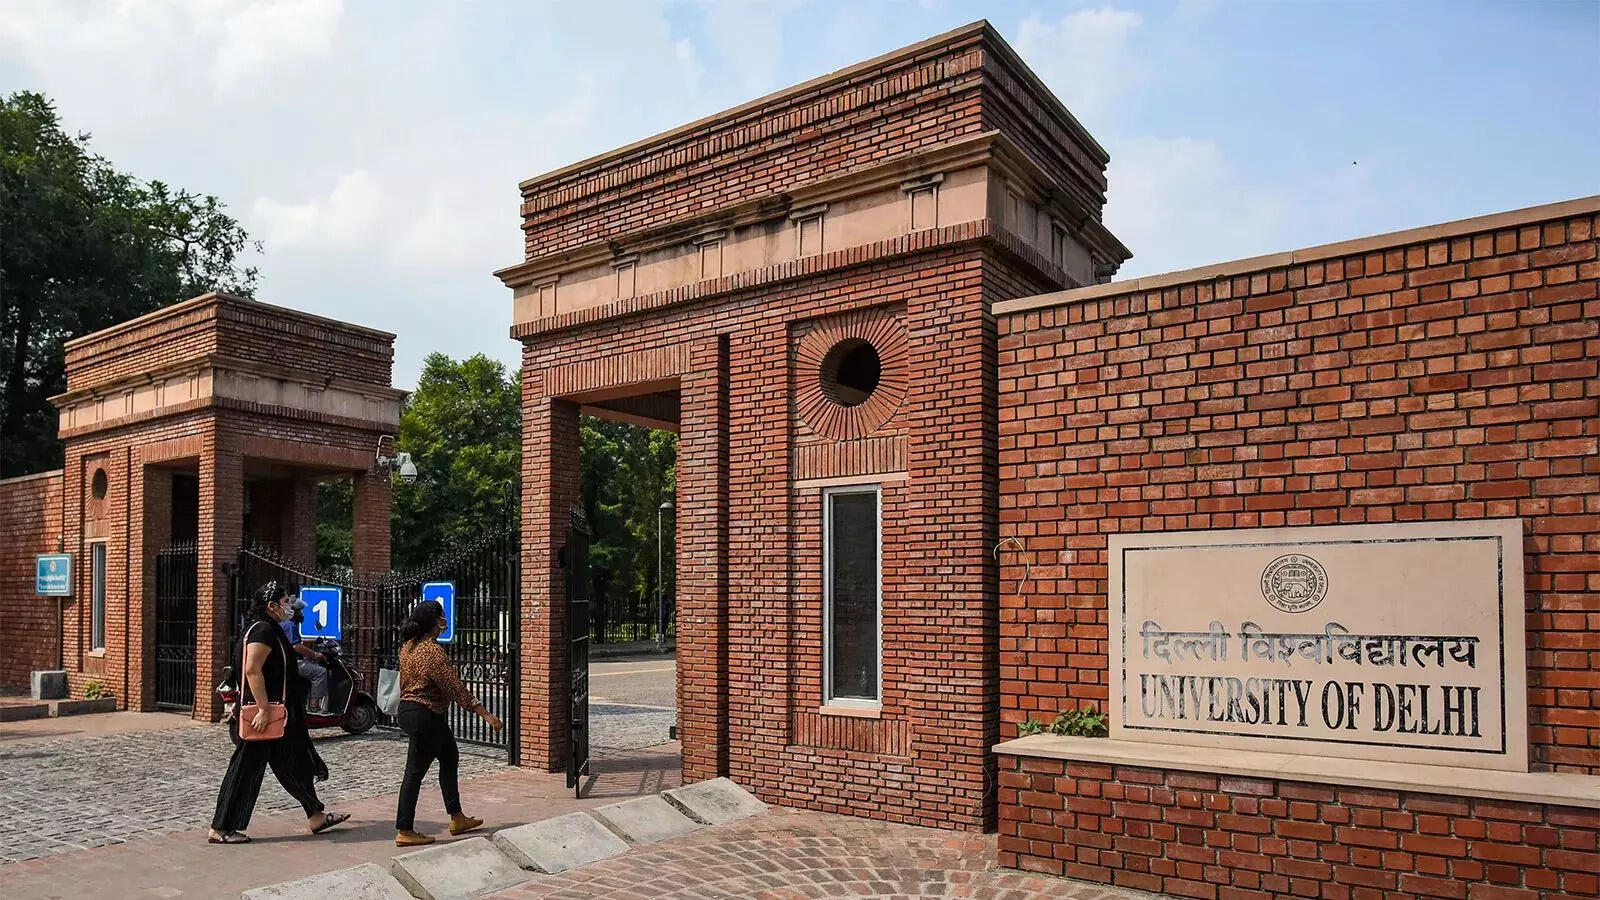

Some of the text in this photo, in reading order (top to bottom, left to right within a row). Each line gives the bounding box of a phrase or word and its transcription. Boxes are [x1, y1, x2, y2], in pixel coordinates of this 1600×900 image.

[312, 600, 328, 627] 1
[1139, 620, 1481, 669] दिल्ली विश्वविद्यालय
[1139, 673, 1482, 738] UNIVERSITY OF DELHI
